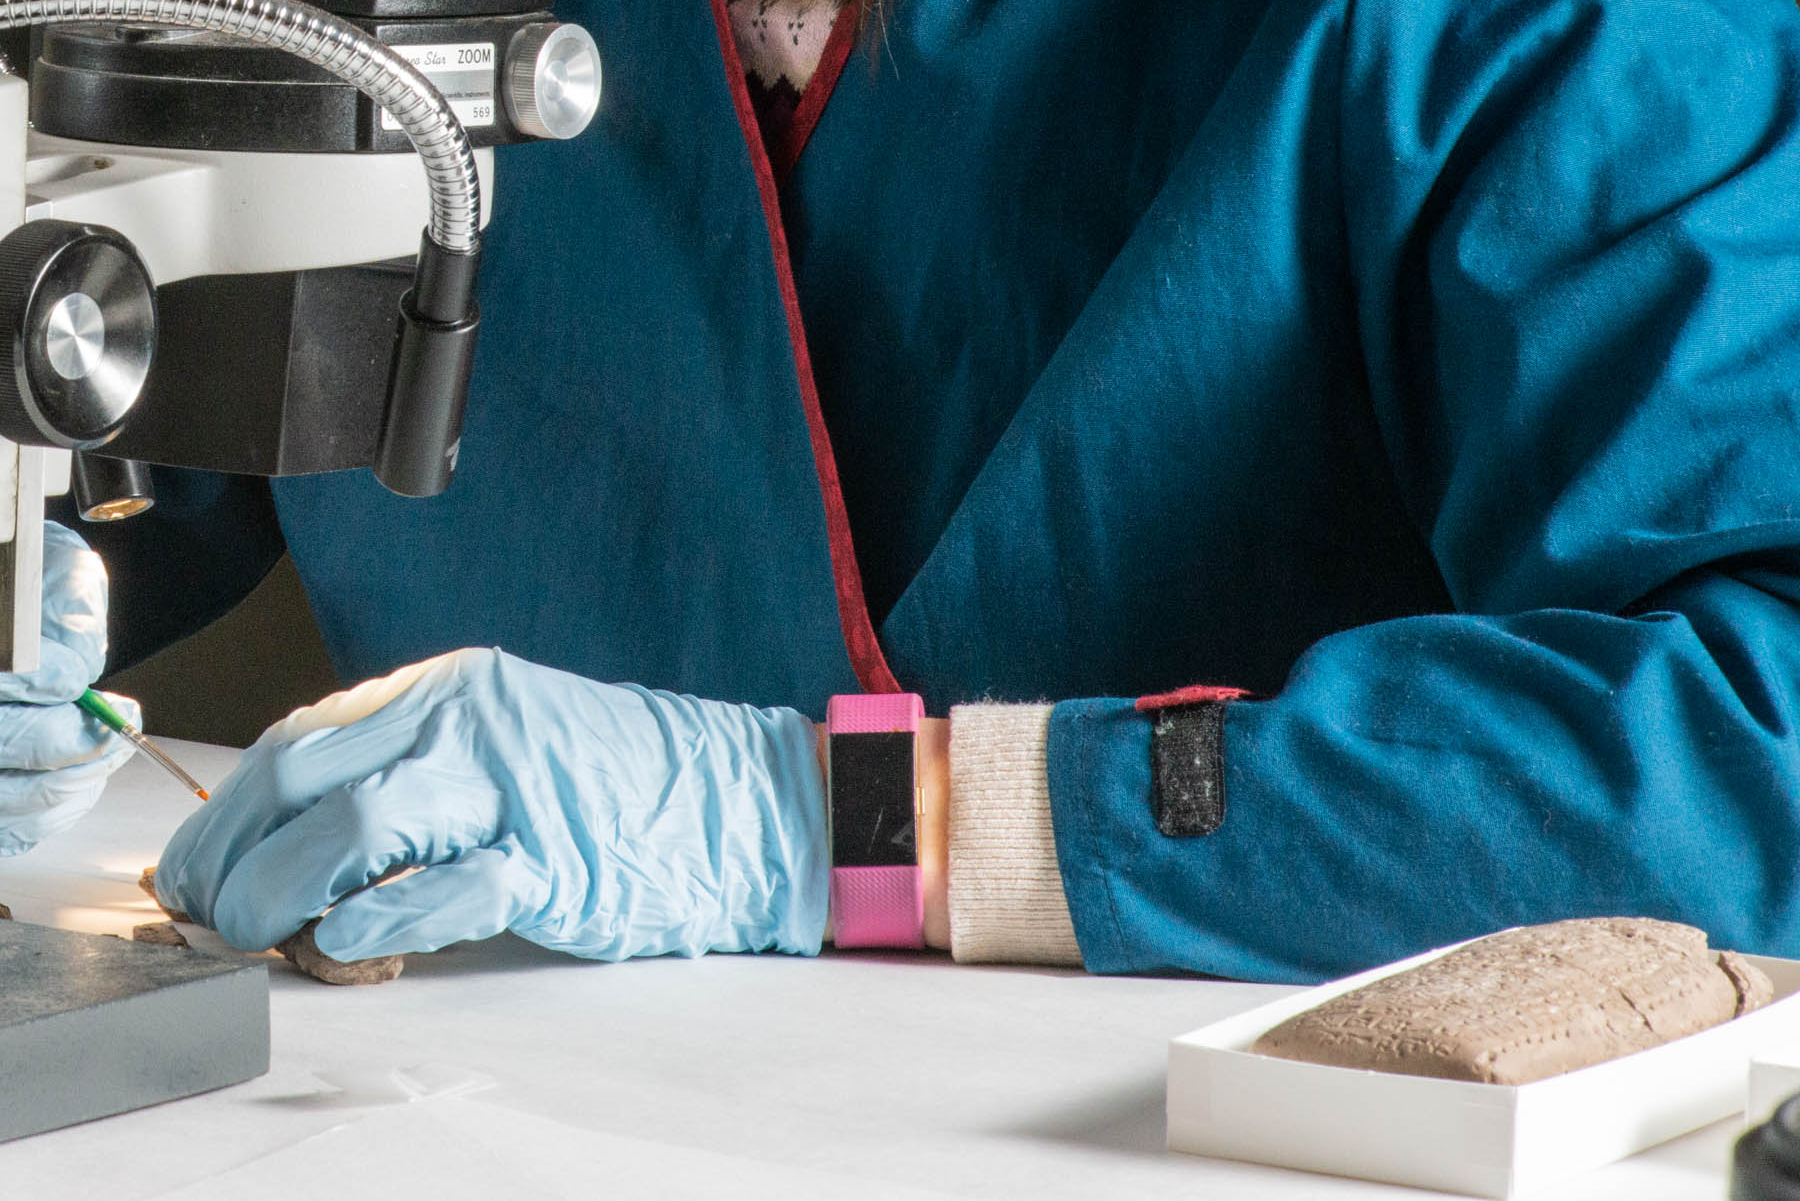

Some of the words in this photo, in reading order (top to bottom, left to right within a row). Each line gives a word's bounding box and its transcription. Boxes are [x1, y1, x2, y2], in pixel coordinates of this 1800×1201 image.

[424, 51, 446, 66] Star
[458, 49, 491, 64] ZOOM
[473, 106, 491, 119] 569
